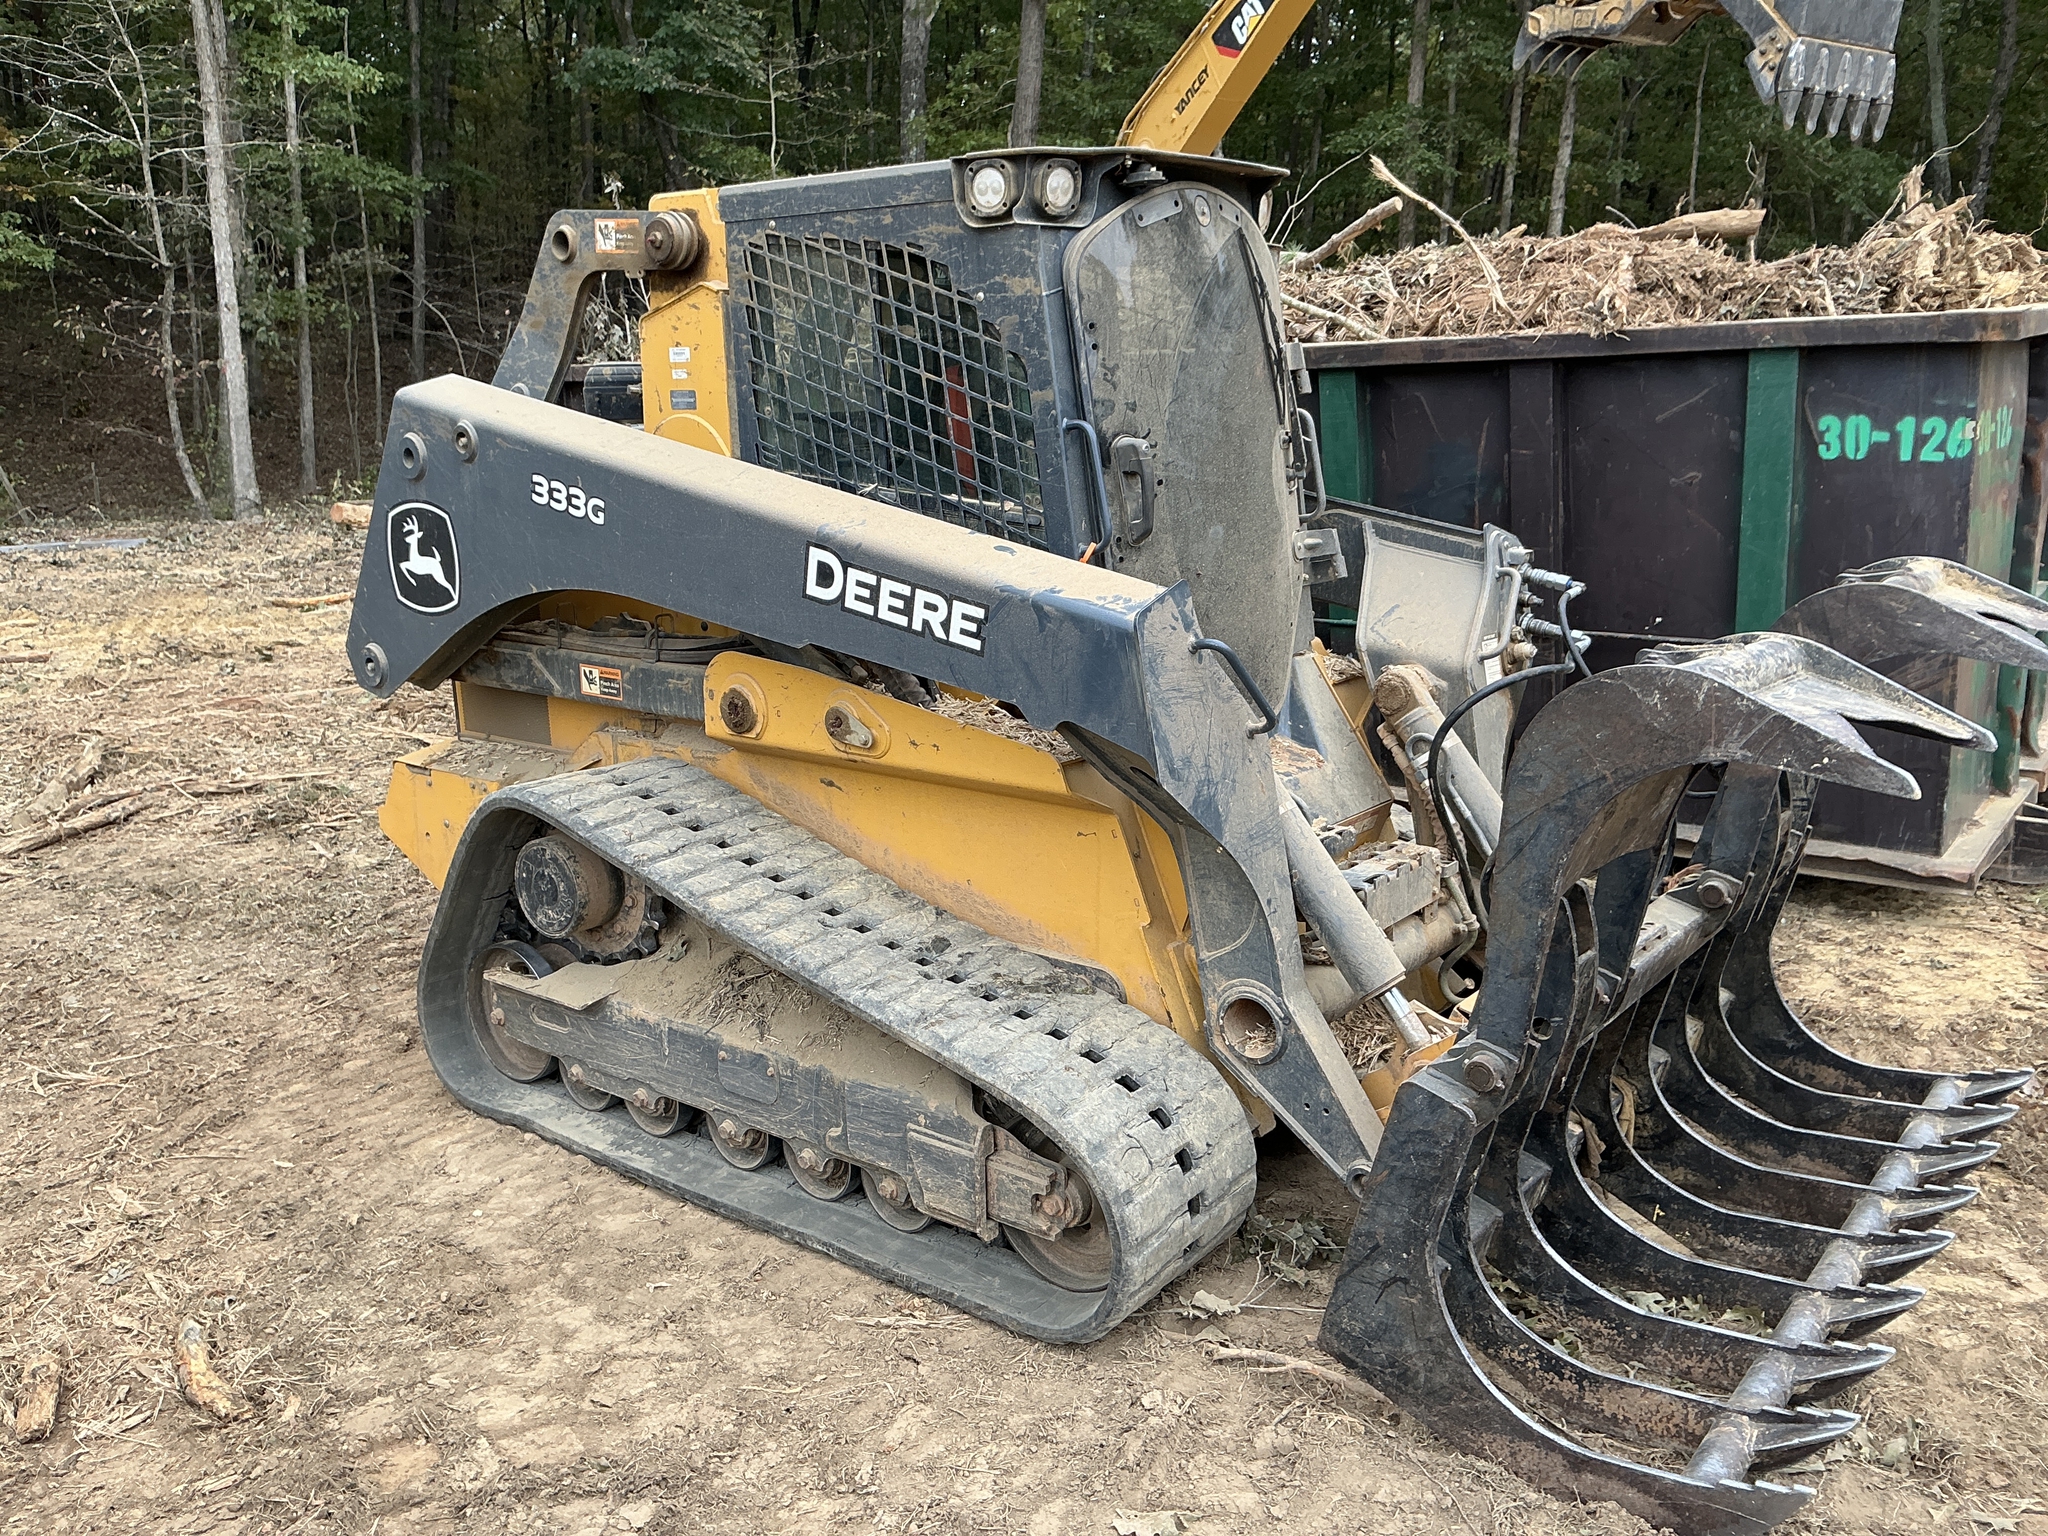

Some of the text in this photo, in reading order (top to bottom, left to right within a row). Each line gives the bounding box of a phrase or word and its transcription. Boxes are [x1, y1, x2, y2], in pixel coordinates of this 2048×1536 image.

[1174, 64, 1210, 115] YANCEY
[531, 474, 605, 525] 333G
[805, 545, 985, 651] DEERE
